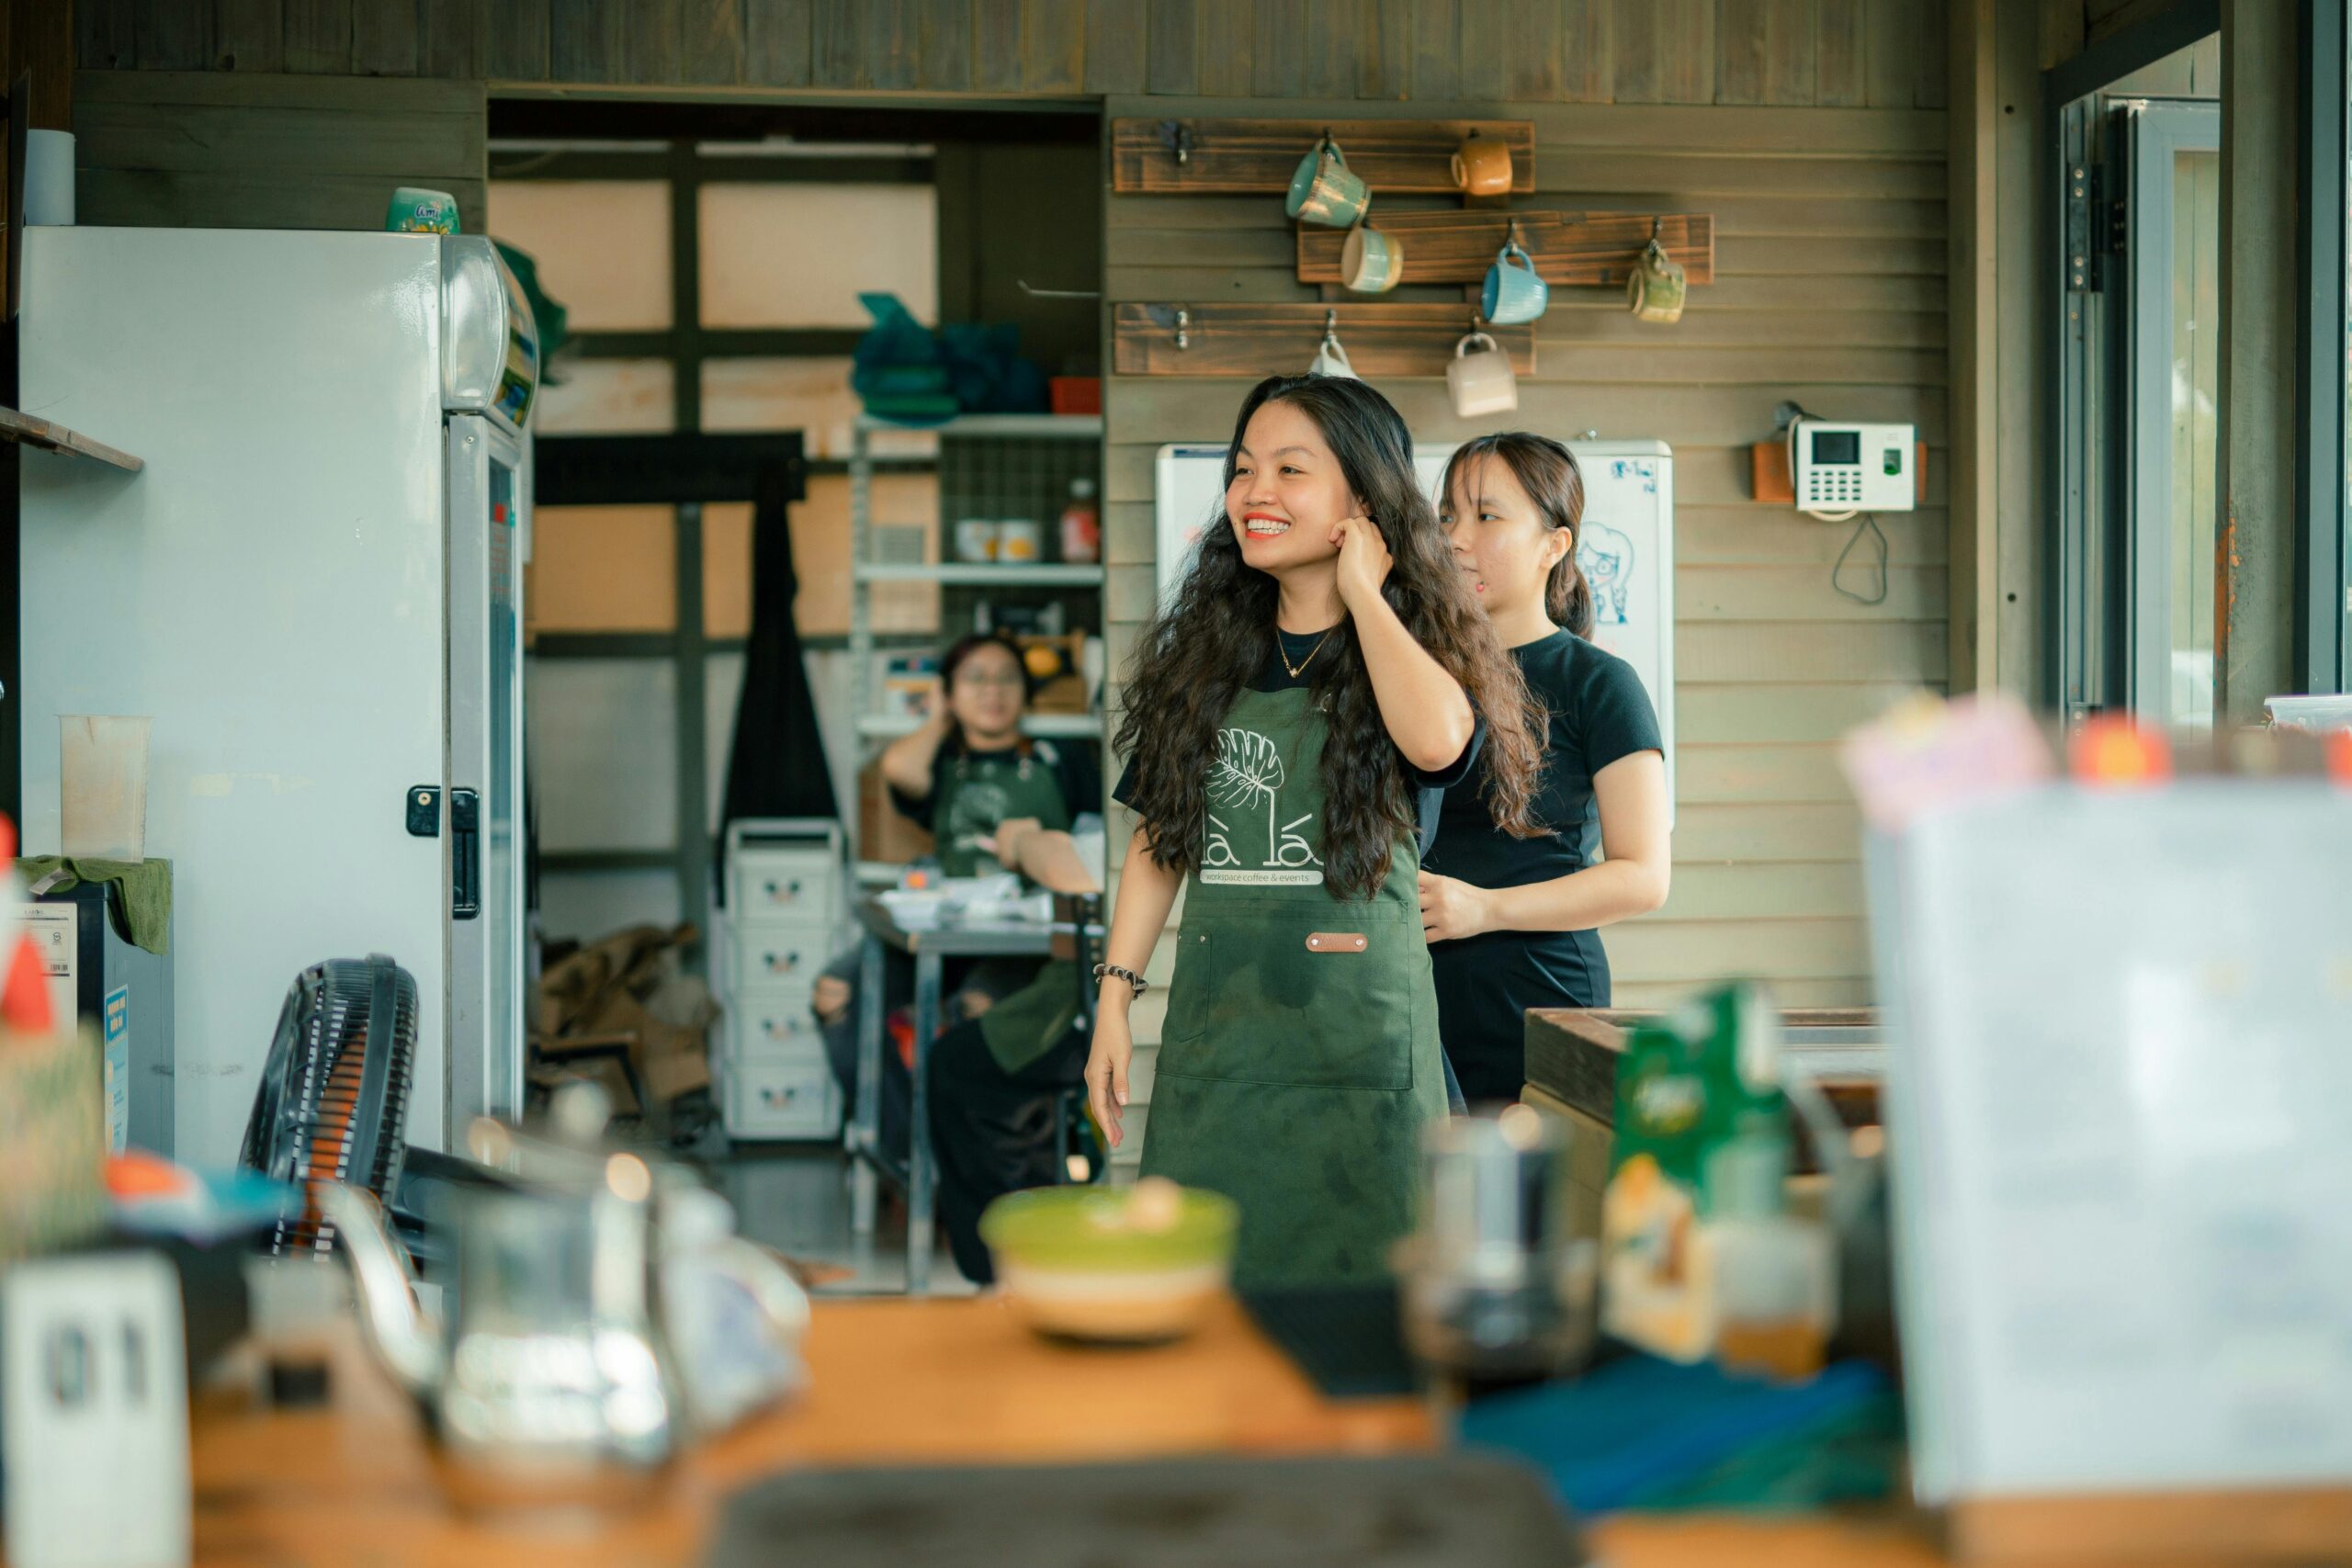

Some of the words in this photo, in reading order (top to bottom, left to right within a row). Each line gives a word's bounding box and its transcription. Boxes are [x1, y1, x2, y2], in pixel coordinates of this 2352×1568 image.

[1205, 872, 1241, 882] workspace
[1242, 873, 1270, 883] coffee
[1271, 873, 1278, 882] &
[1279, 874, 1309, 883] events
